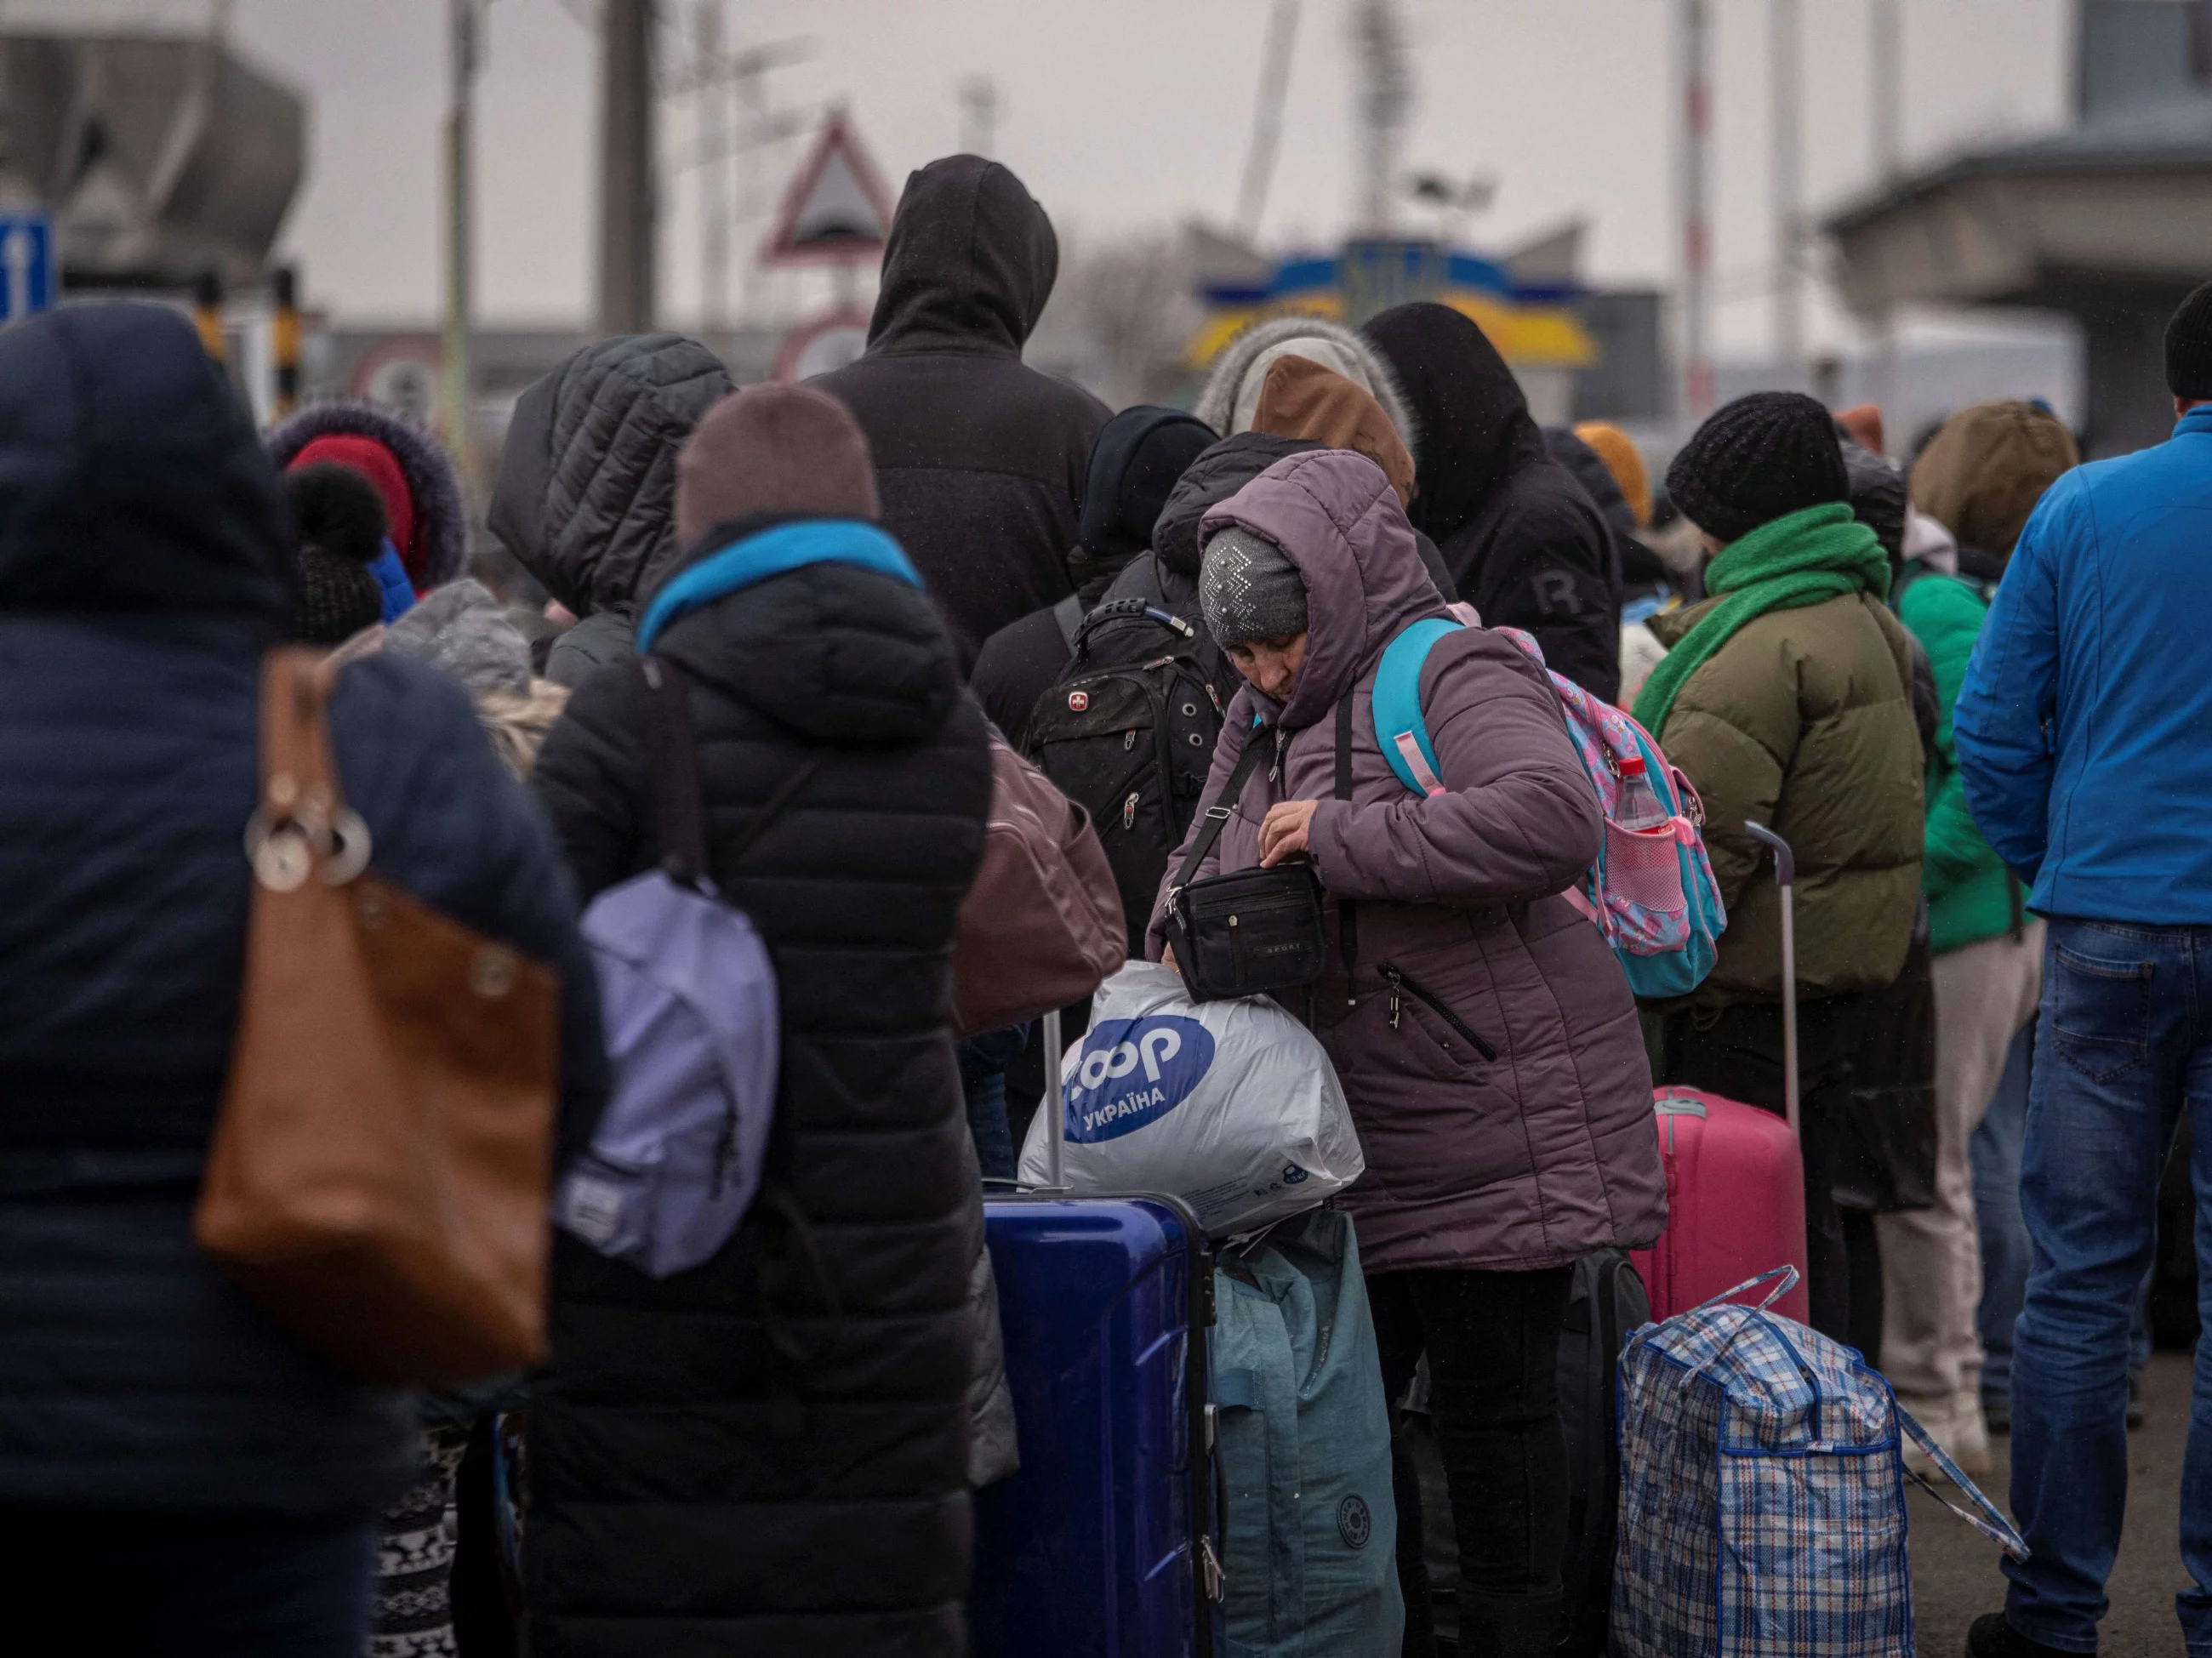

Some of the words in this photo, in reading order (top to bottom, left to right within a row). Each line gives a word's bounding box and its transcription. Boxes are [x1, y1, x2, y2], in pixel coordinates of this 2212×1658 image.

[1531, 569, 1582, 614] R
[1267, 943, 1300, 954] SPORT
[1083, 1087, 1166, 1131] УКРАЇНА
